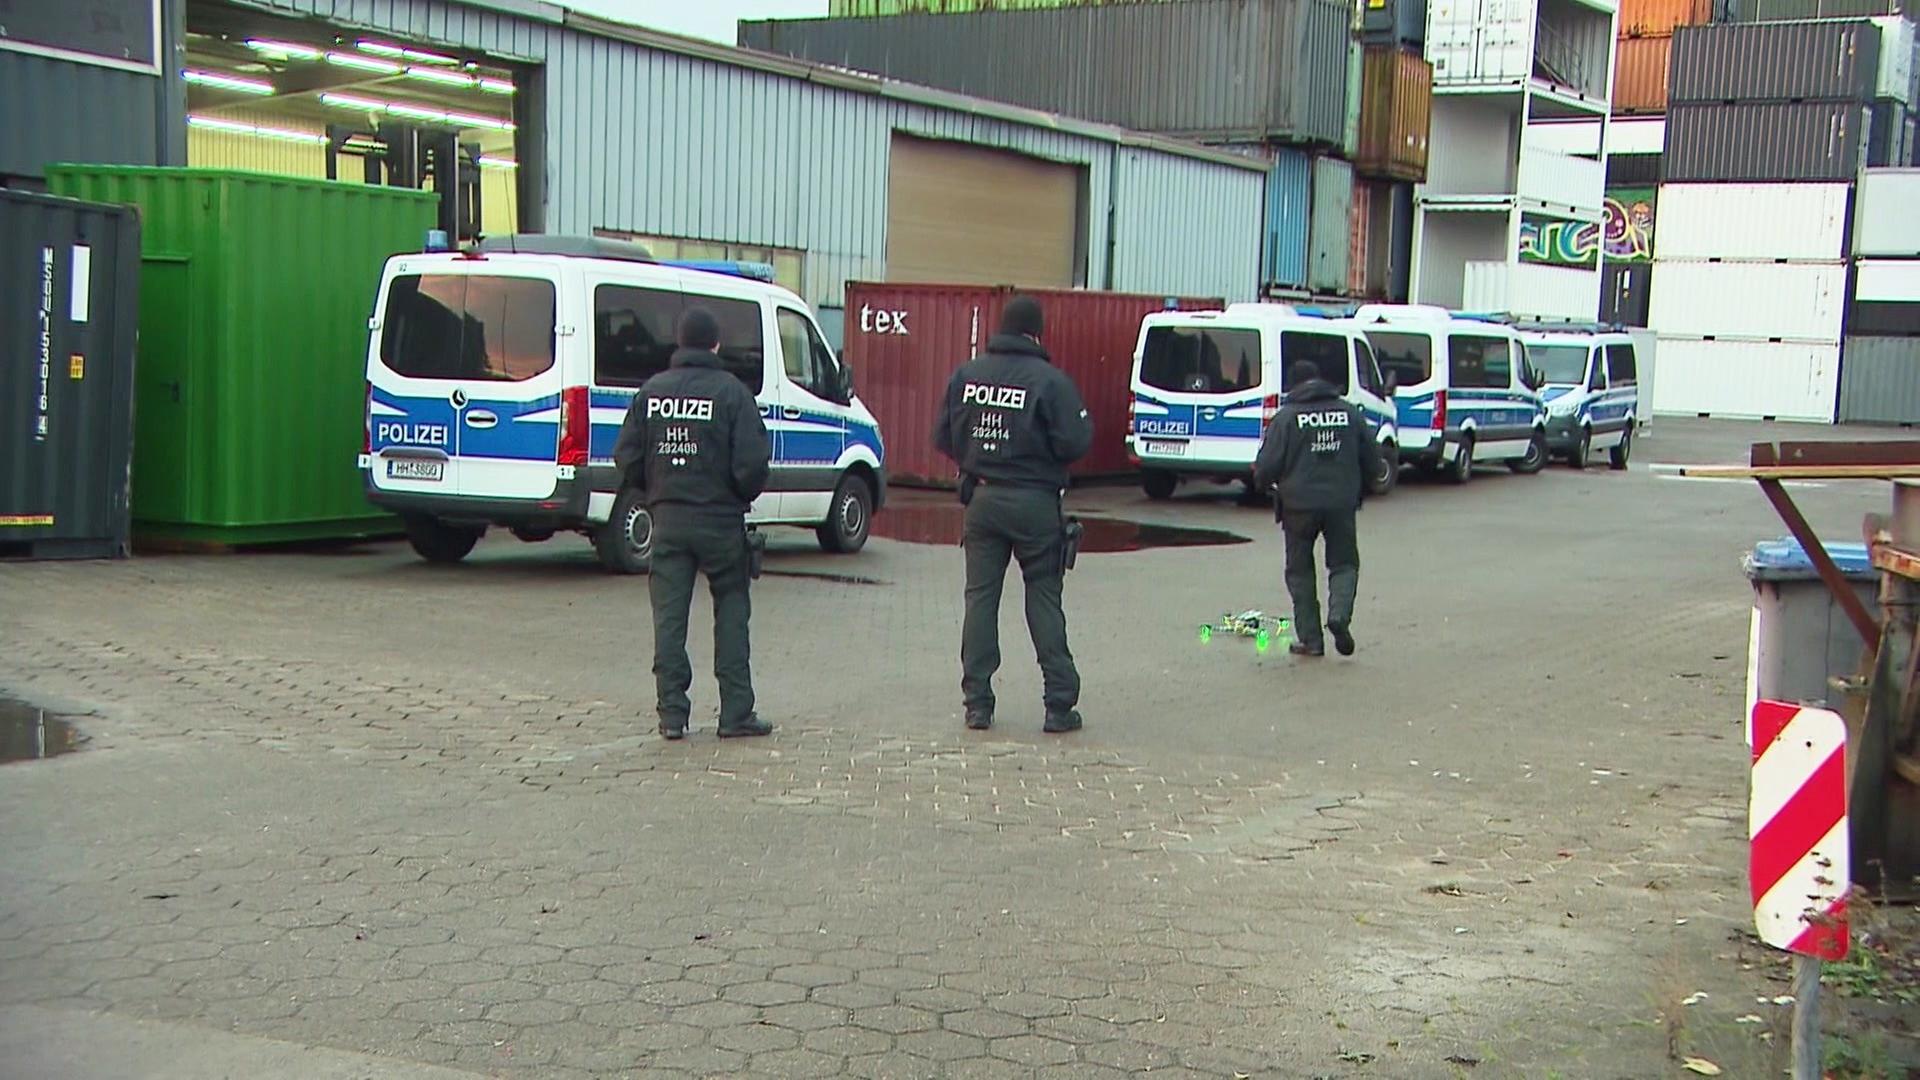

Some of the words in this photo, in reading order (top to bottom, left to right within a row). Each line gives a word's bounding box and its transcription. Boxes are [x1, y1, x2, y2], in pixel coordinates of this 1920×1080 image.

[861, 303, 910, 334] tex
[963, 383, 1027, 409] POLIZEI
[647, 398, 713, 420] POLIZEI
[981, 412, 1002, 427] HH
[1140, 420, 1189, 434] POLIZEI
[1297, 411, 1349, 428] POLIZEI
[379, 423, 448, 445] POLIZEI
[666, 427, 689, 441] HH
[1317, 430, 1334, 442] HH
